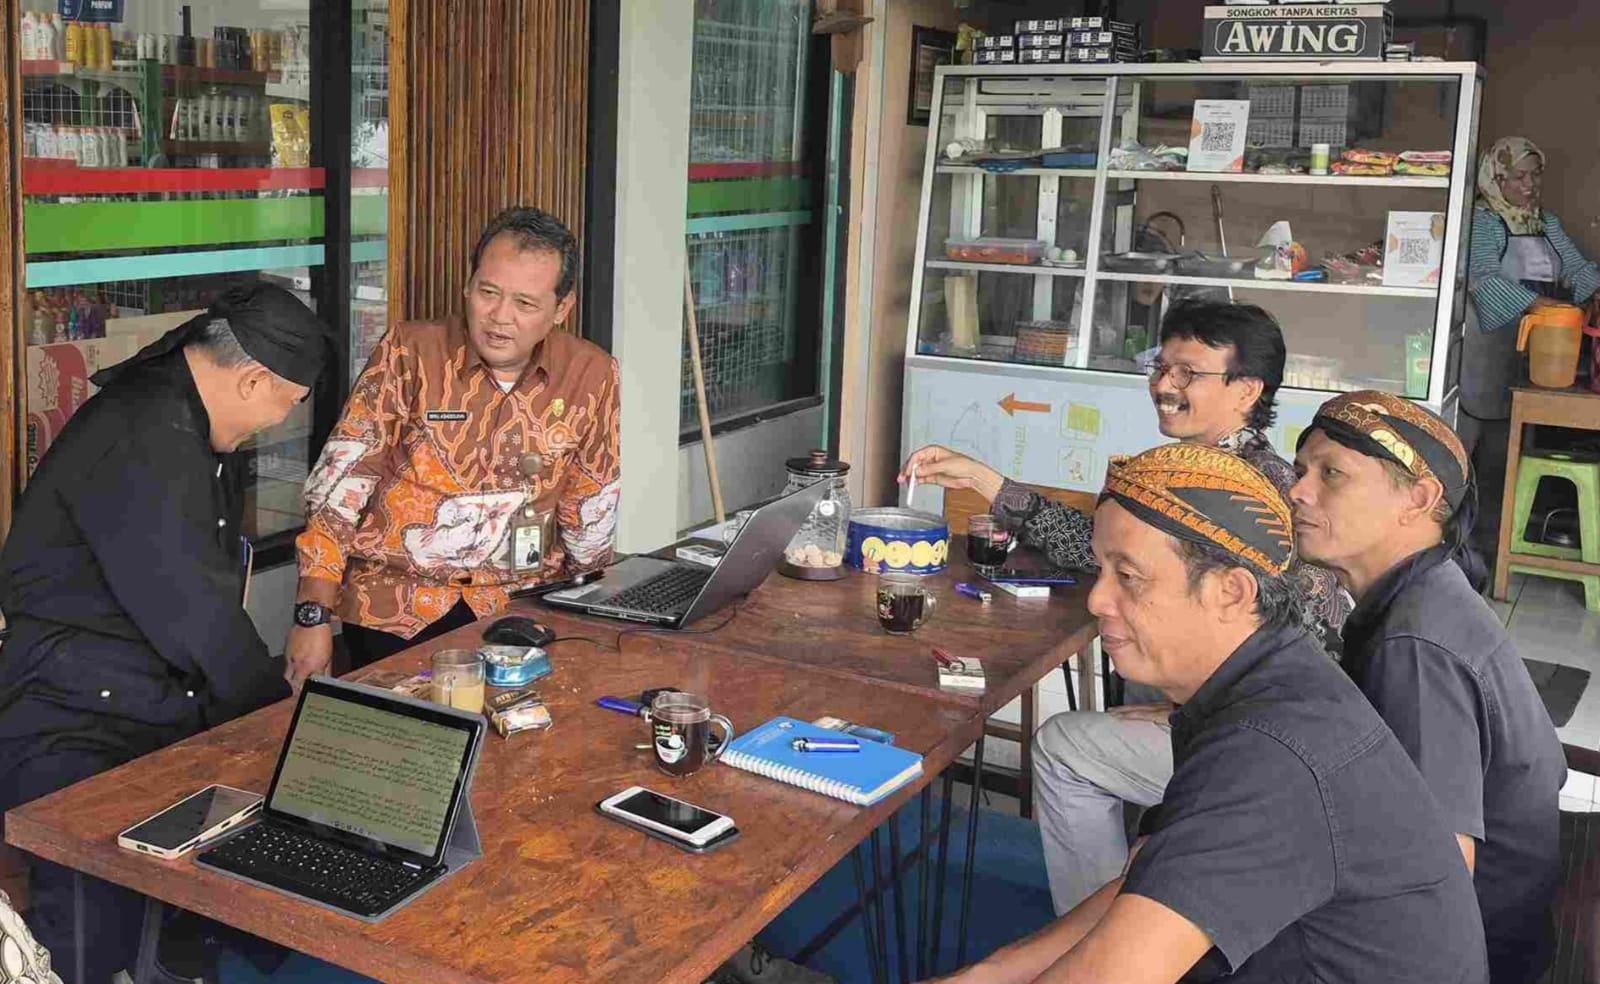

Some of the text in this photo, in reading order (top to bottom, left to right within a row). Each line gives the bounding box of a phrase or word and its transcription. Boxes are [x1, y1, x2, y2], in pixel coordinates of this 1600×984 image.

[1227, 7, 1358, 17] SONGKOK TANPA KERTAS
